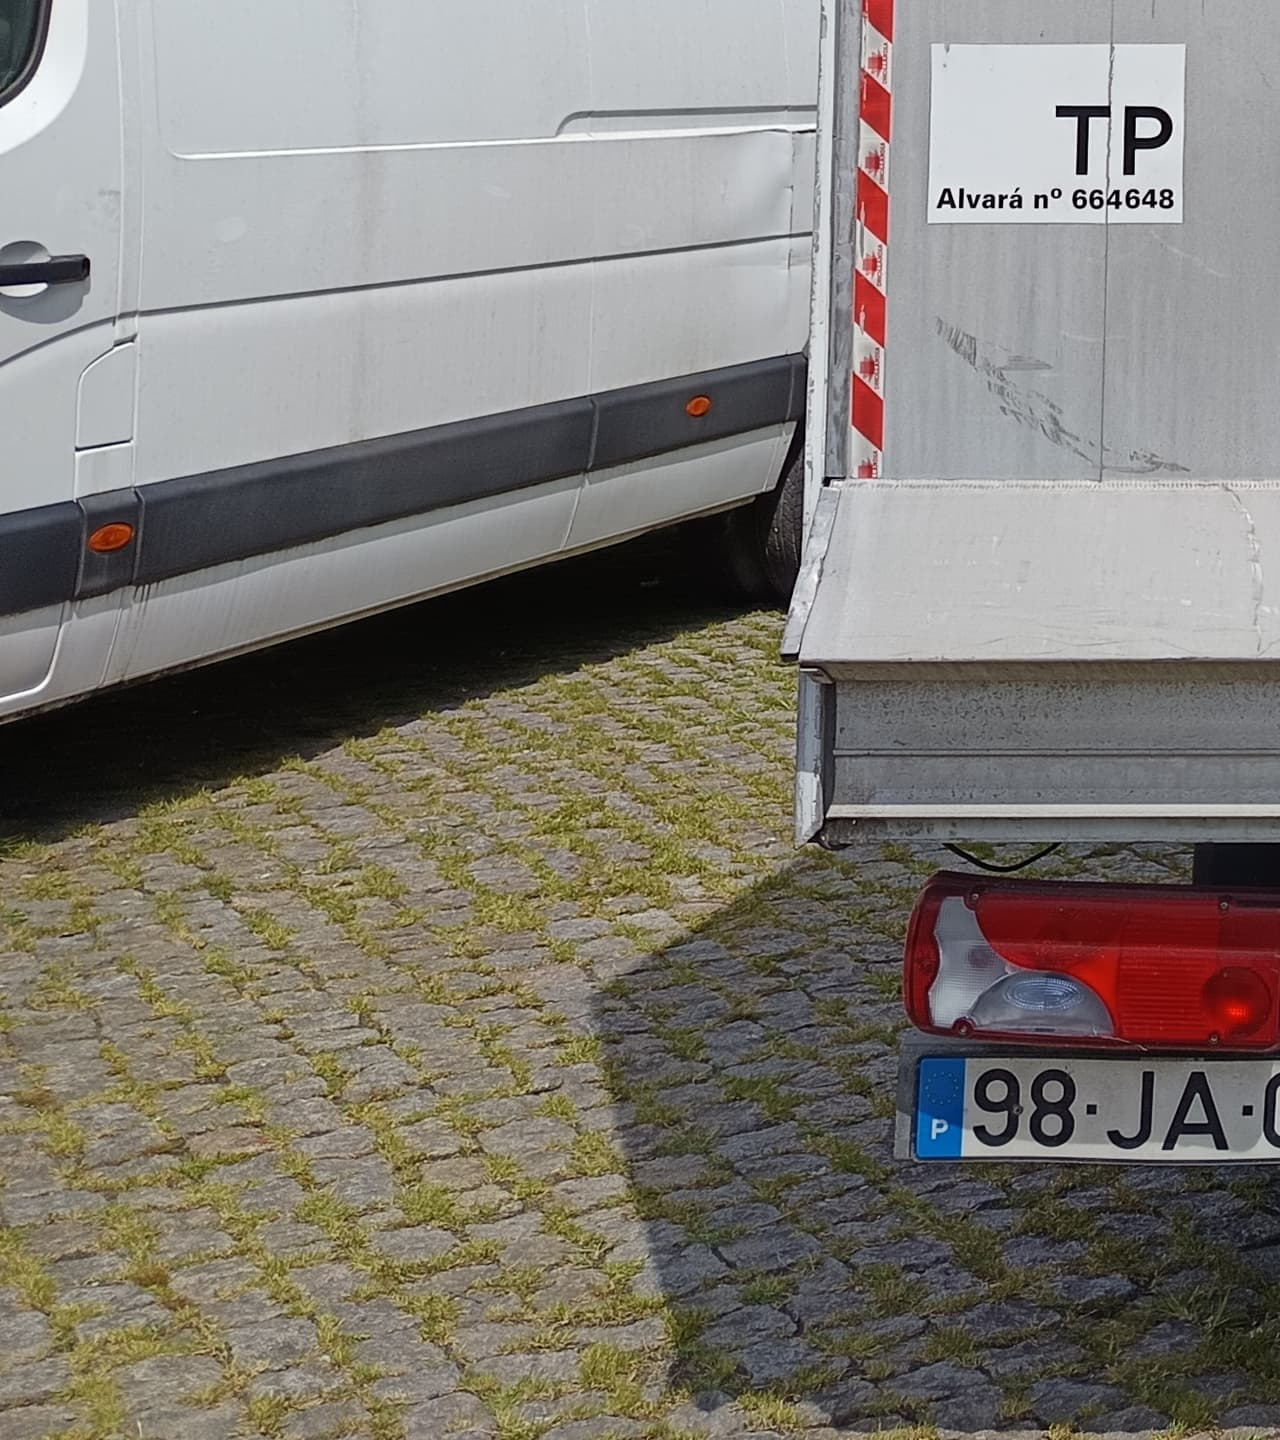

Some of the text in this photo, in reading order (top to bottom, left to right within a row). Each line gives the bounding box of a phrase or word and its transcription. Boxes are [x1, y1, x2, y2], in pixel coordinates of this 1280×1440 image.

[1055, 105, 1173, 176] TP
[936, 187, 1175, 210] Alvará nº 664648
[931, 1118, 948, 1140] P
